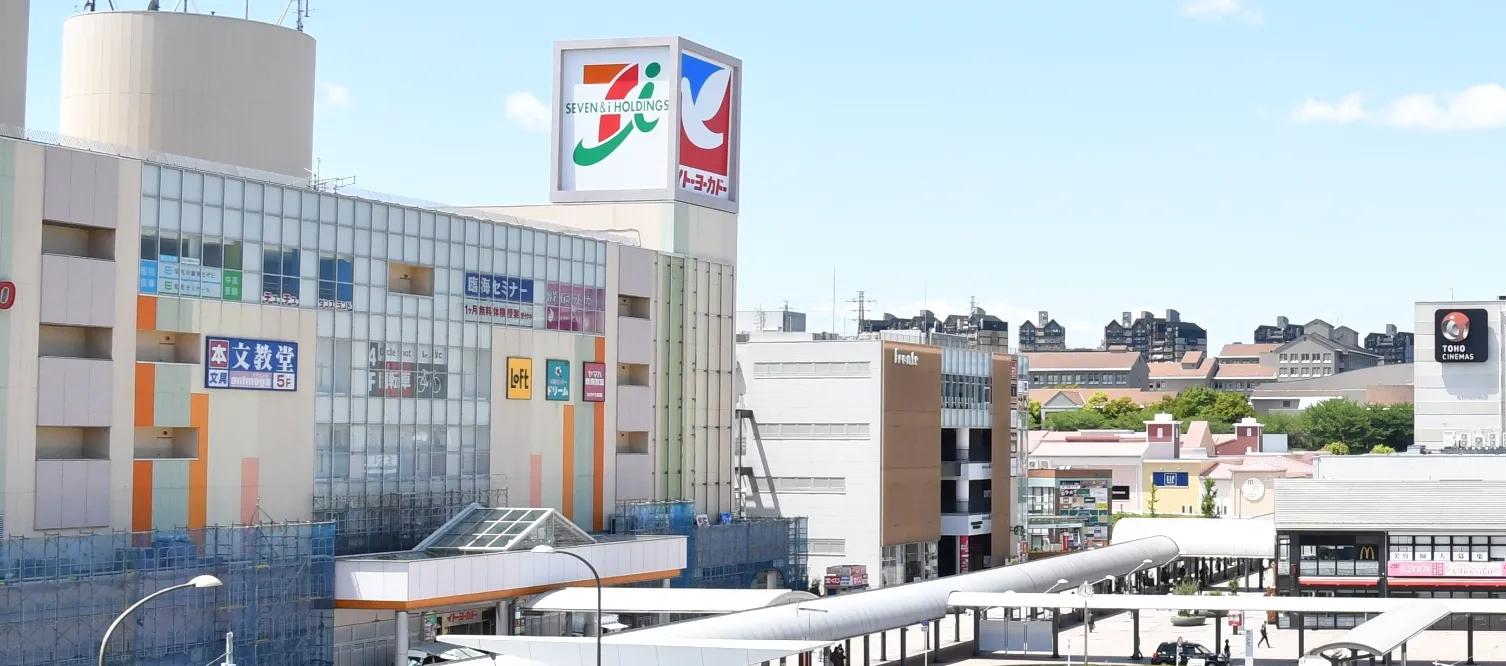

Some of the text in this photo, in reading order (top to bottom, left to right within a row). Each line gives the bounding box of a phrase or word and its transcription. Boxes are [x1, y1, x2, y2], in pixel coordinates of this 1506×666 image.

[566, 102, 598, 114] SEVEN
[599, 101, 607, 113] &
[615, 100, 669, 112] HOLDINGS
[468, 275, 528, 298] 臨海セミナー
[1442, 344, 1466, 353] TOHO
[211, 342, 295, 373] 本 文教堂
[209, 372, 228, 385] 文具
[276, 375, 292, 388] 5F
[548, 386, 568, 396] ドリーム
